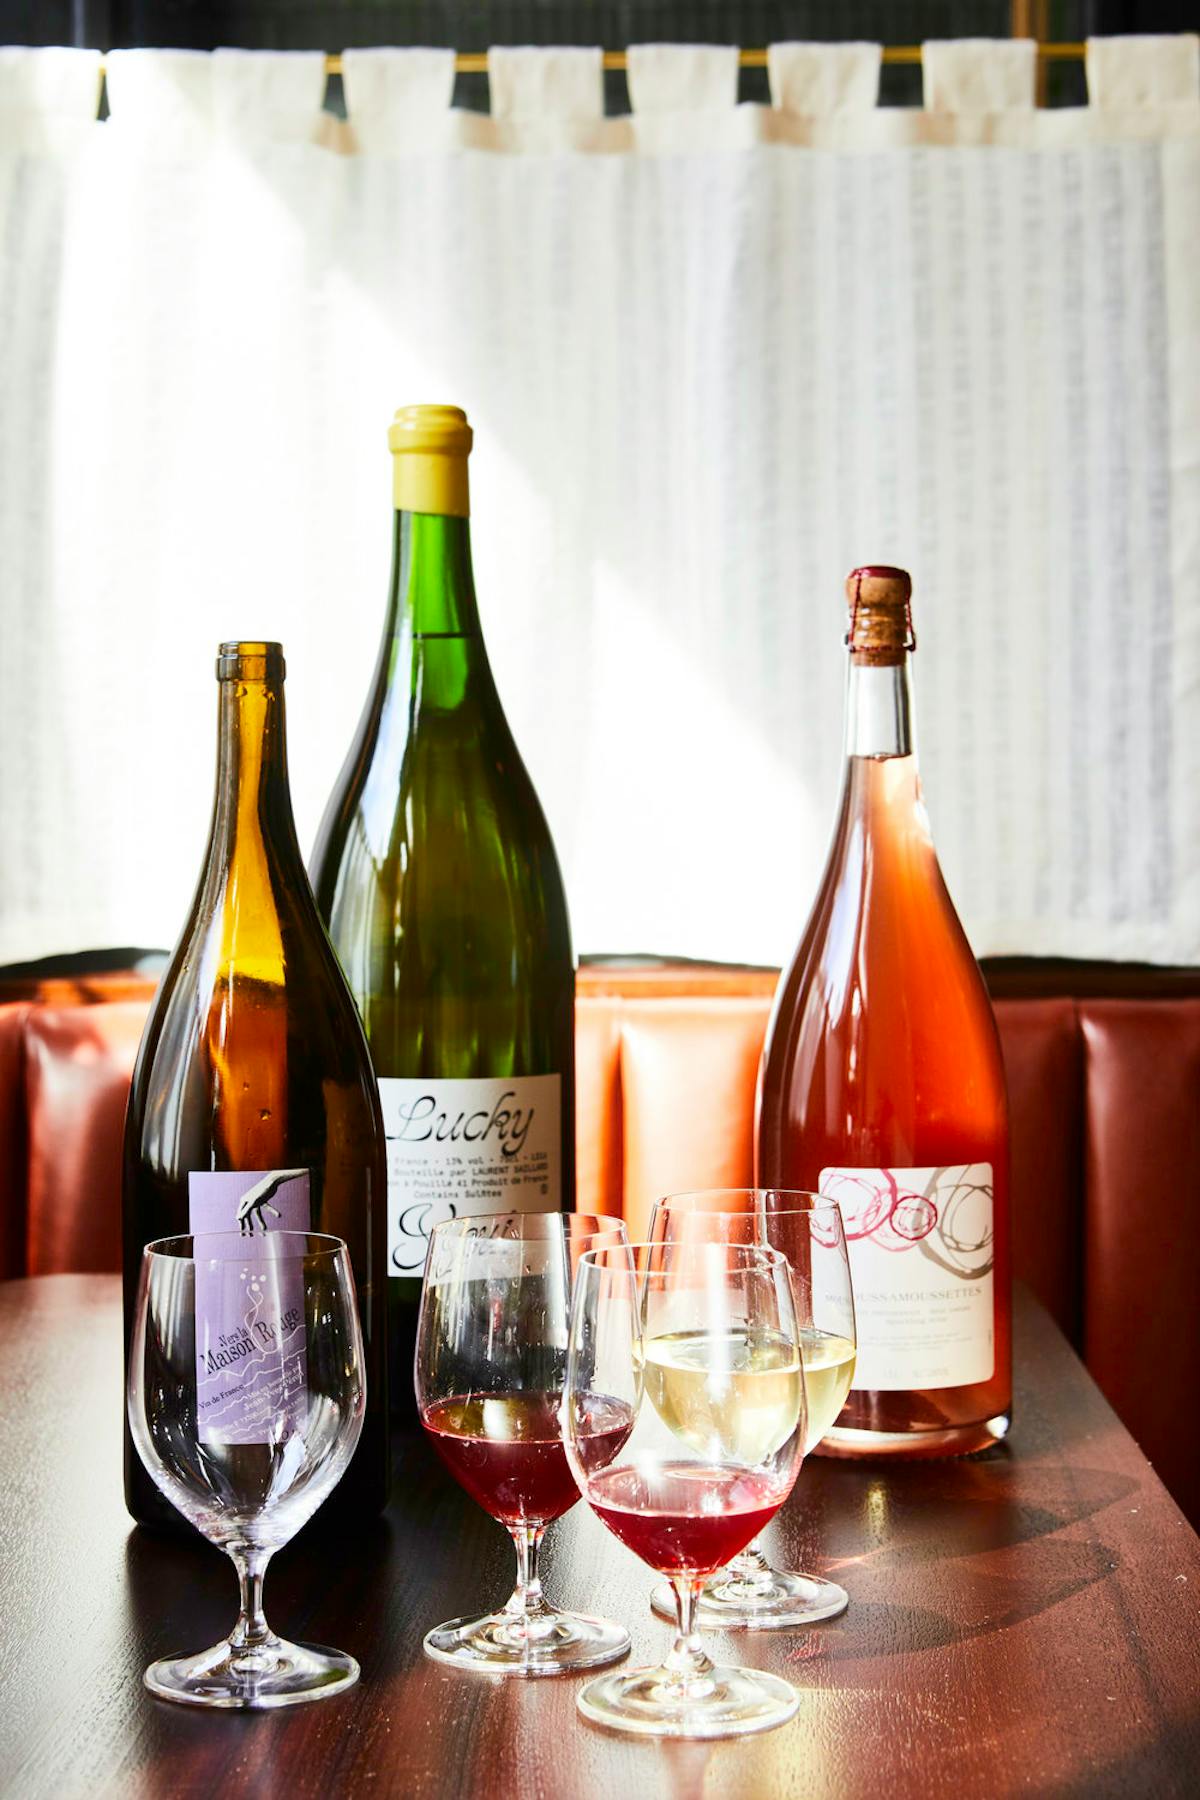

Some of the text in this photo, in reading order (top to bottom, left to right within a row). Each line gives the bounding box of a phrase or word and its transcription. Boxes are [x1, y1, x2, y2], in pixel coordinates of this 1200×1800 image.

[386, 1091, 535, 1156] Lucky
[468, 1156, 485, 1165] vol
[450, 1169, 467, 1178] par
[472, 1166, 509, 1176] LAURENT
[471, 1177, 508, 1187] Produit
[523, 1174, 549, 1184] France
[413, 1189, 459, 1199] Contains
[200, 1307, 301, 1375] Maison Rouge
[219, 1332, 241, 1347] Vers
[220, 1384, 245, 1399] France
